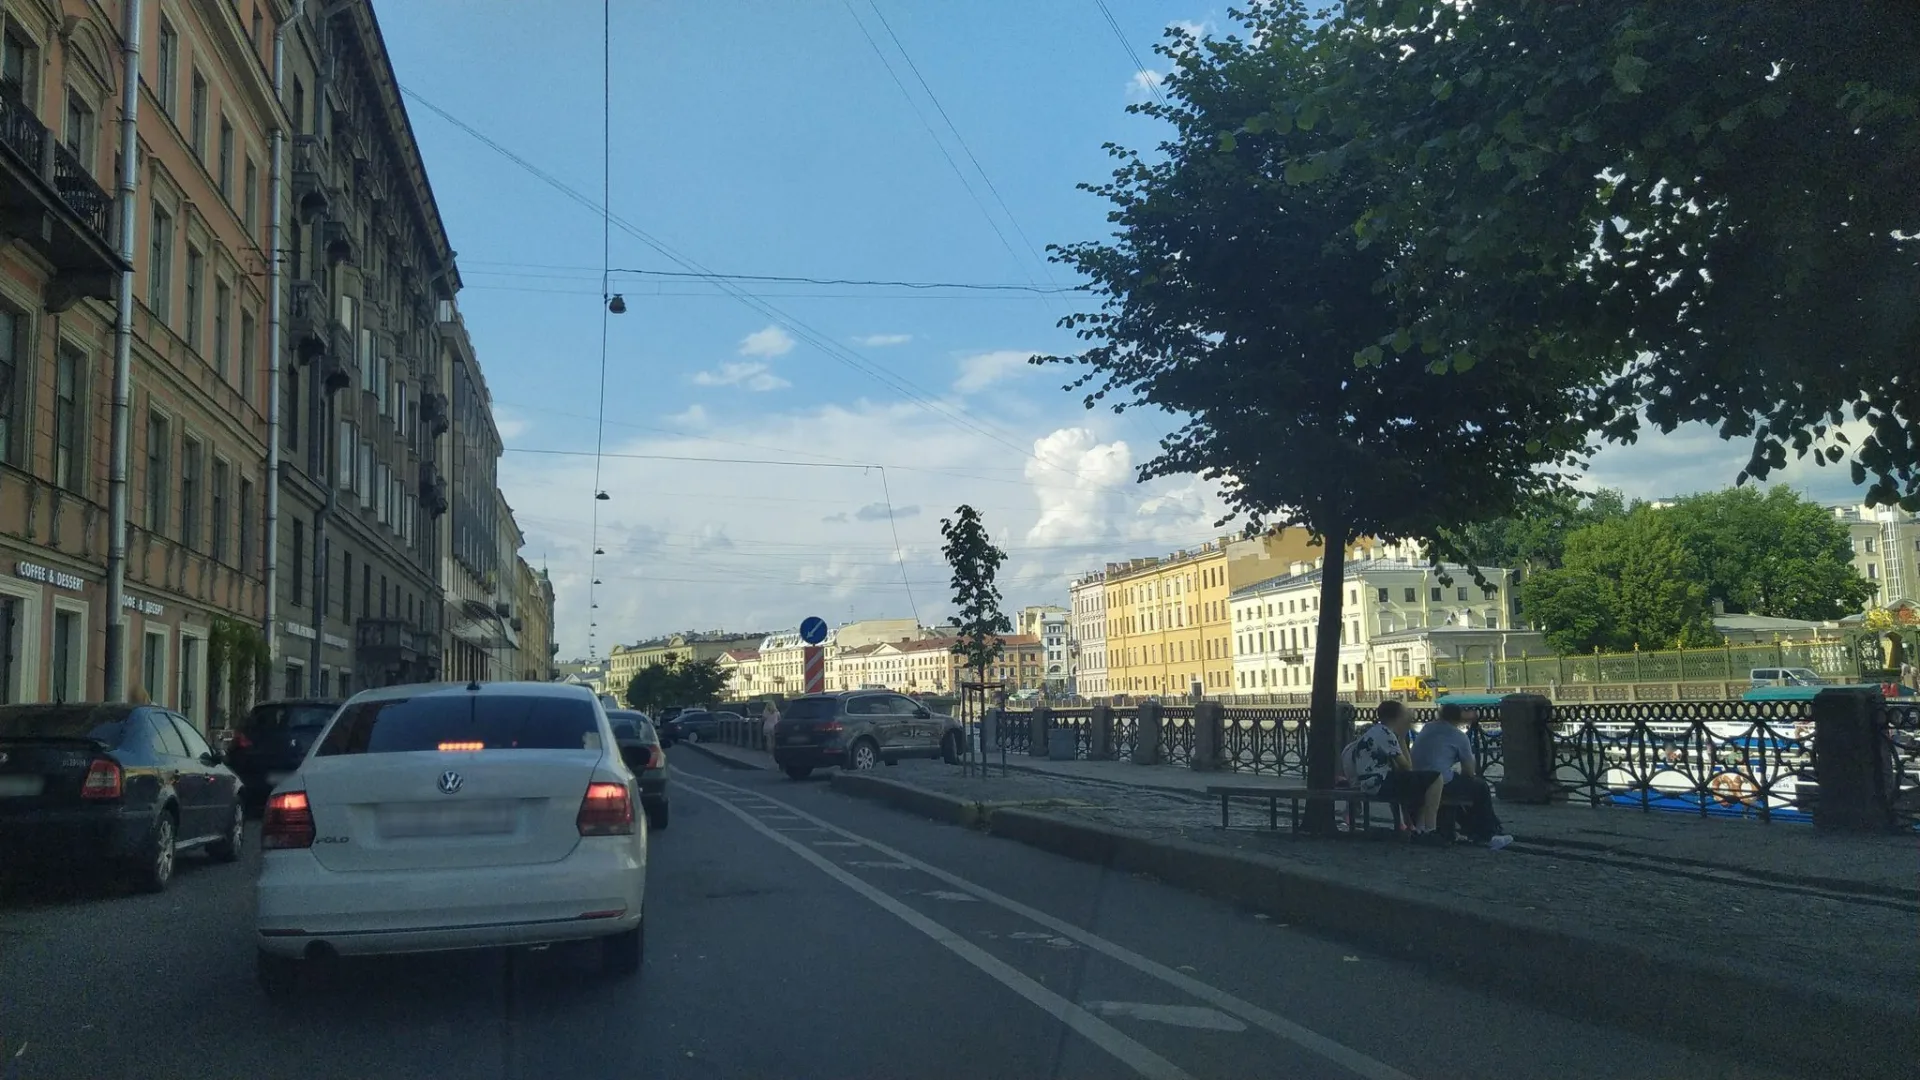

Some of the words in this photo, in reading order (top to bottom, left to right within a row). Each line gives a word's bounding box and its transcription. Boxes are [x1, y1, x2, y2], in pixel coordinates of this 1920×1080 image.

[20, 561, 46, 581] COFFEE
[49, 569, 54, 583] &
[56, 571, 84, 592] DESSERT
